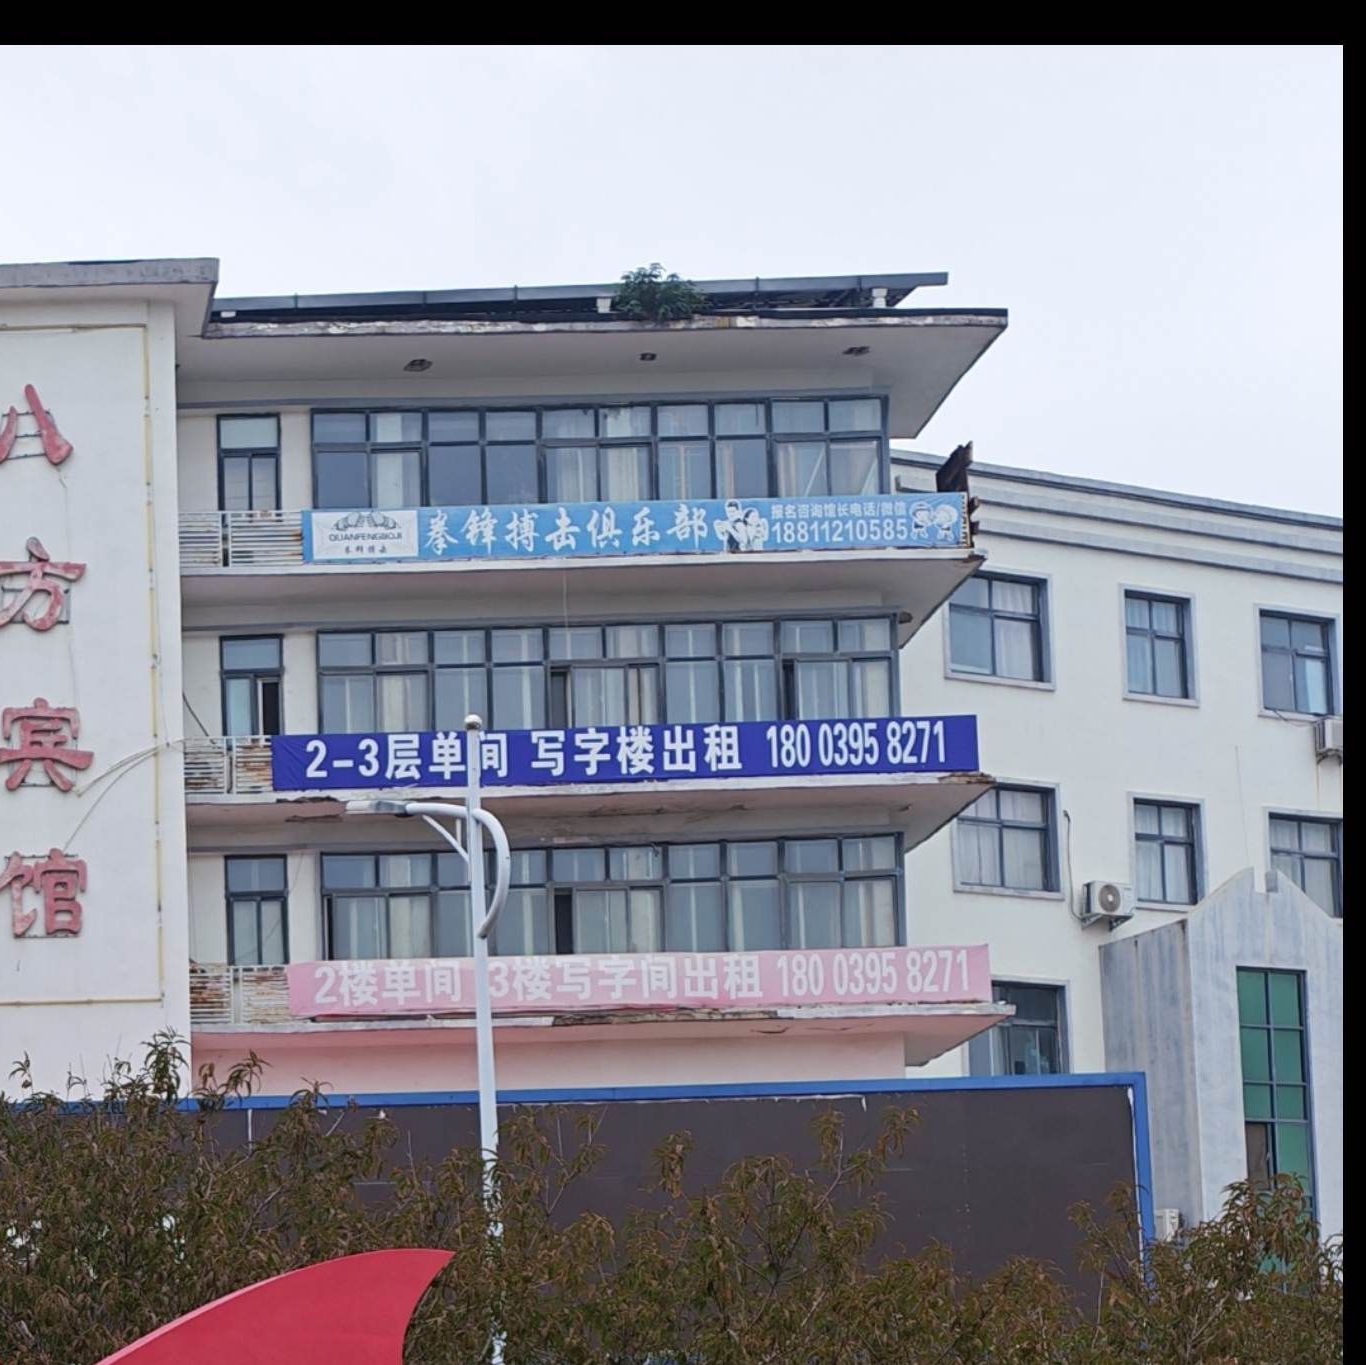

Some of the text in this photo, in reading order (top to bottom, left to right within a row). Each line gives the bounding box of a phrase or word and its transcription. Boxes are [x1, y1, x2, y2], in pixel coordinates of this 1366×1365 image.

[426, 503, 706, 555] 拳锋搏击俱乐部
[771, 518, 908, 544] 18811210585
[305, 719, 946, 780] 2-3层单间 写字楼出租 180 0395 8271
[314, 949, 969, 1007] 2楼单间 3楼写字间出租 180 0395 8271
